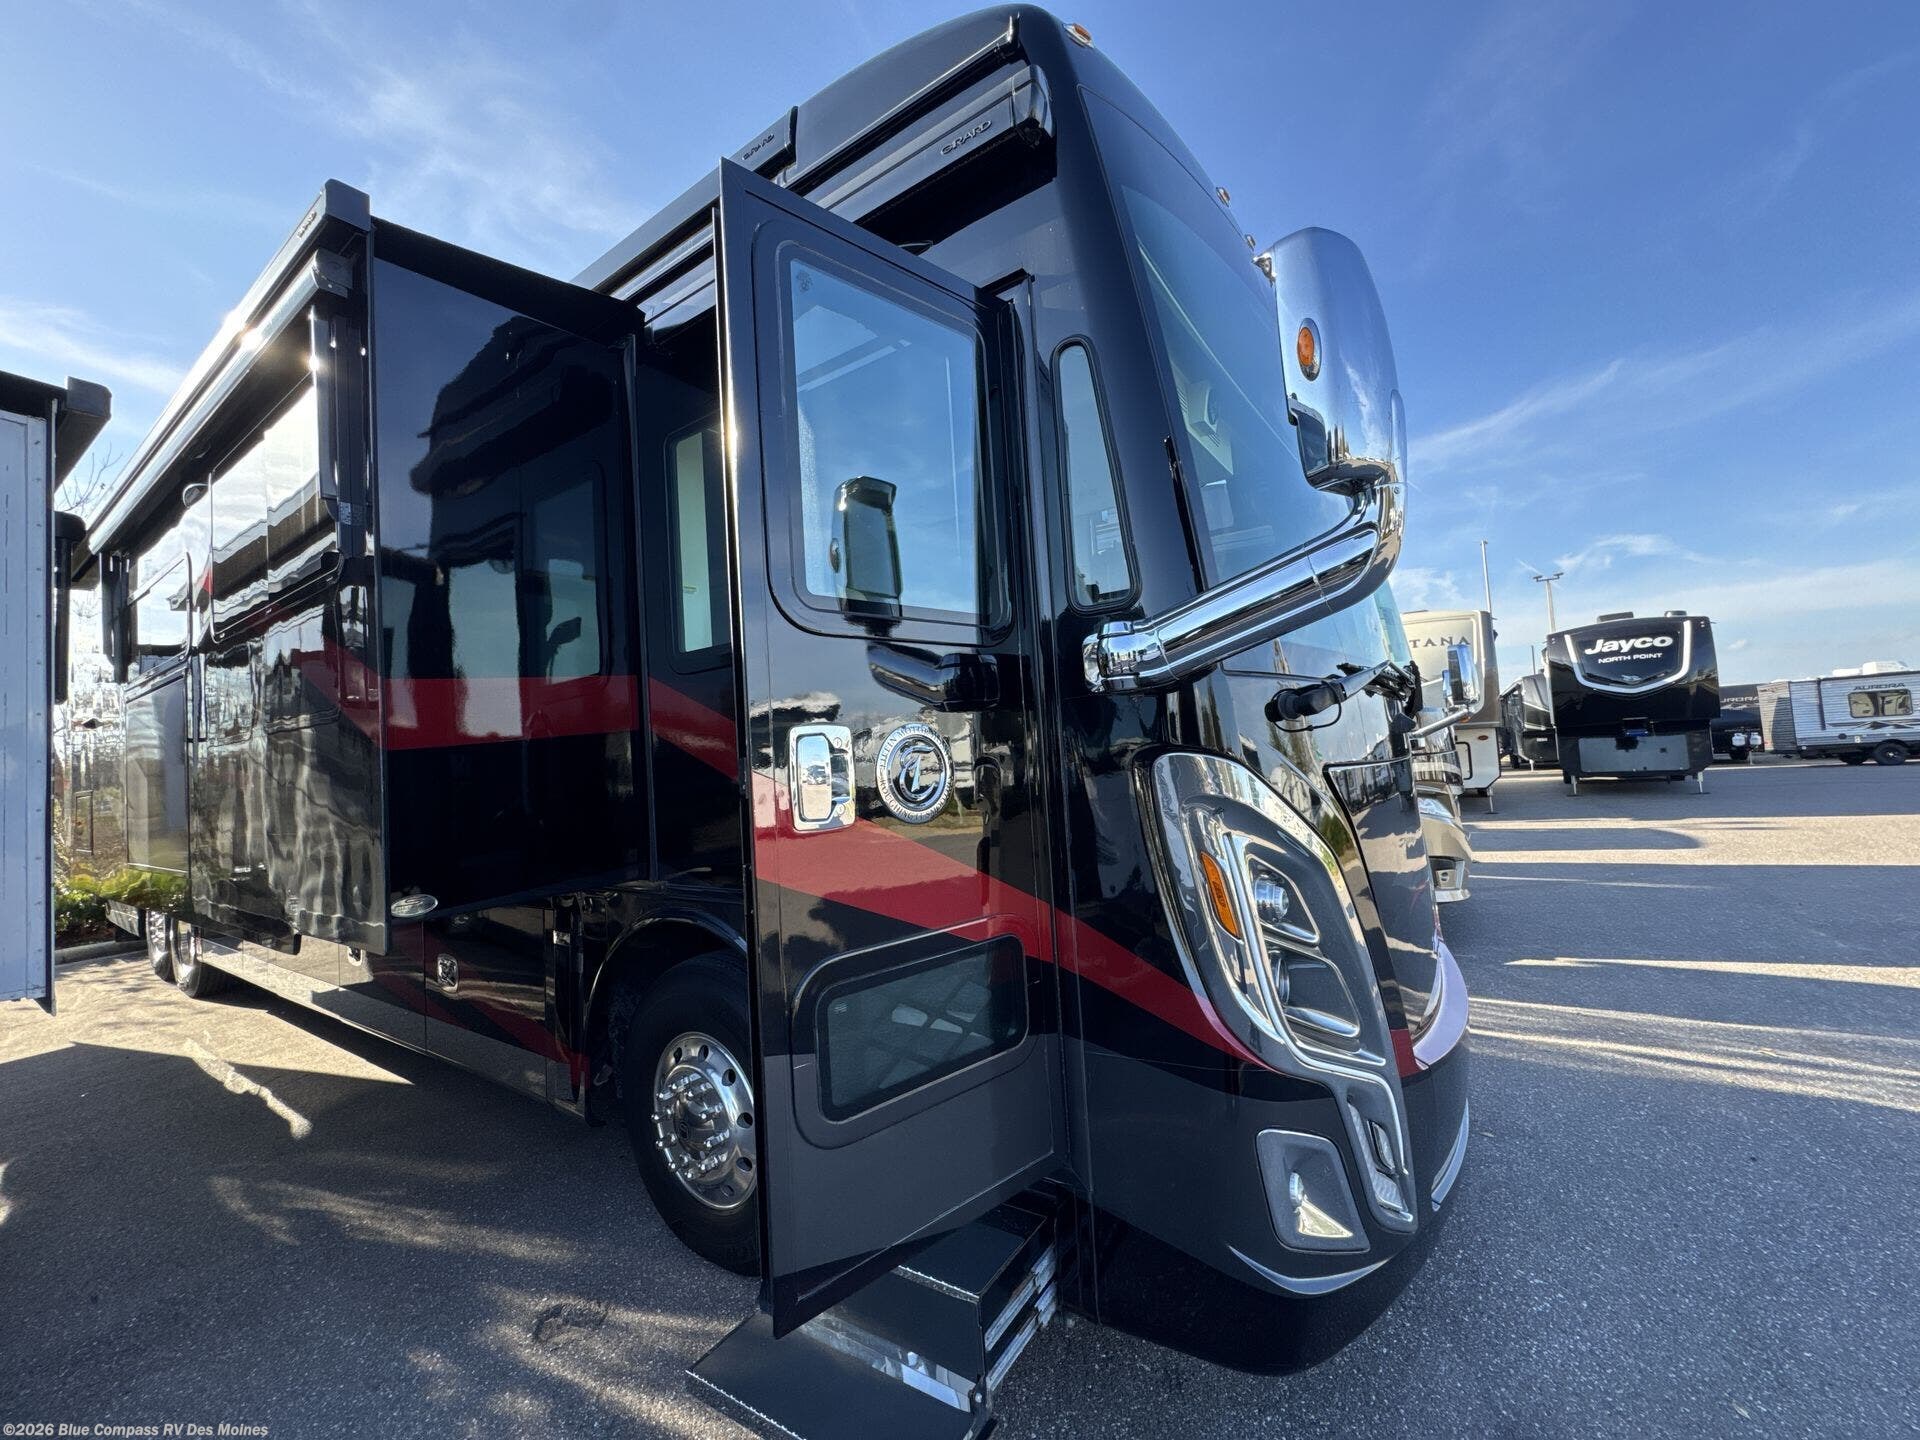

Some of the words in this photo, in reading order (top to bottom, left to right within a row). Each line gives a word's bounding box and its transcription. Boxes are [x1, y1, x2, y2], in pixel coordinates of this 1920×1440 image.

[1408, 636, 1471, 648] TANA
[1584, 635, 1673, 655] Jayco
[1598, 655, 1631, 664] NORTH
[1632, 652, 1663, 660] POINT
[1853, 682, 1906, 691] AURORA
